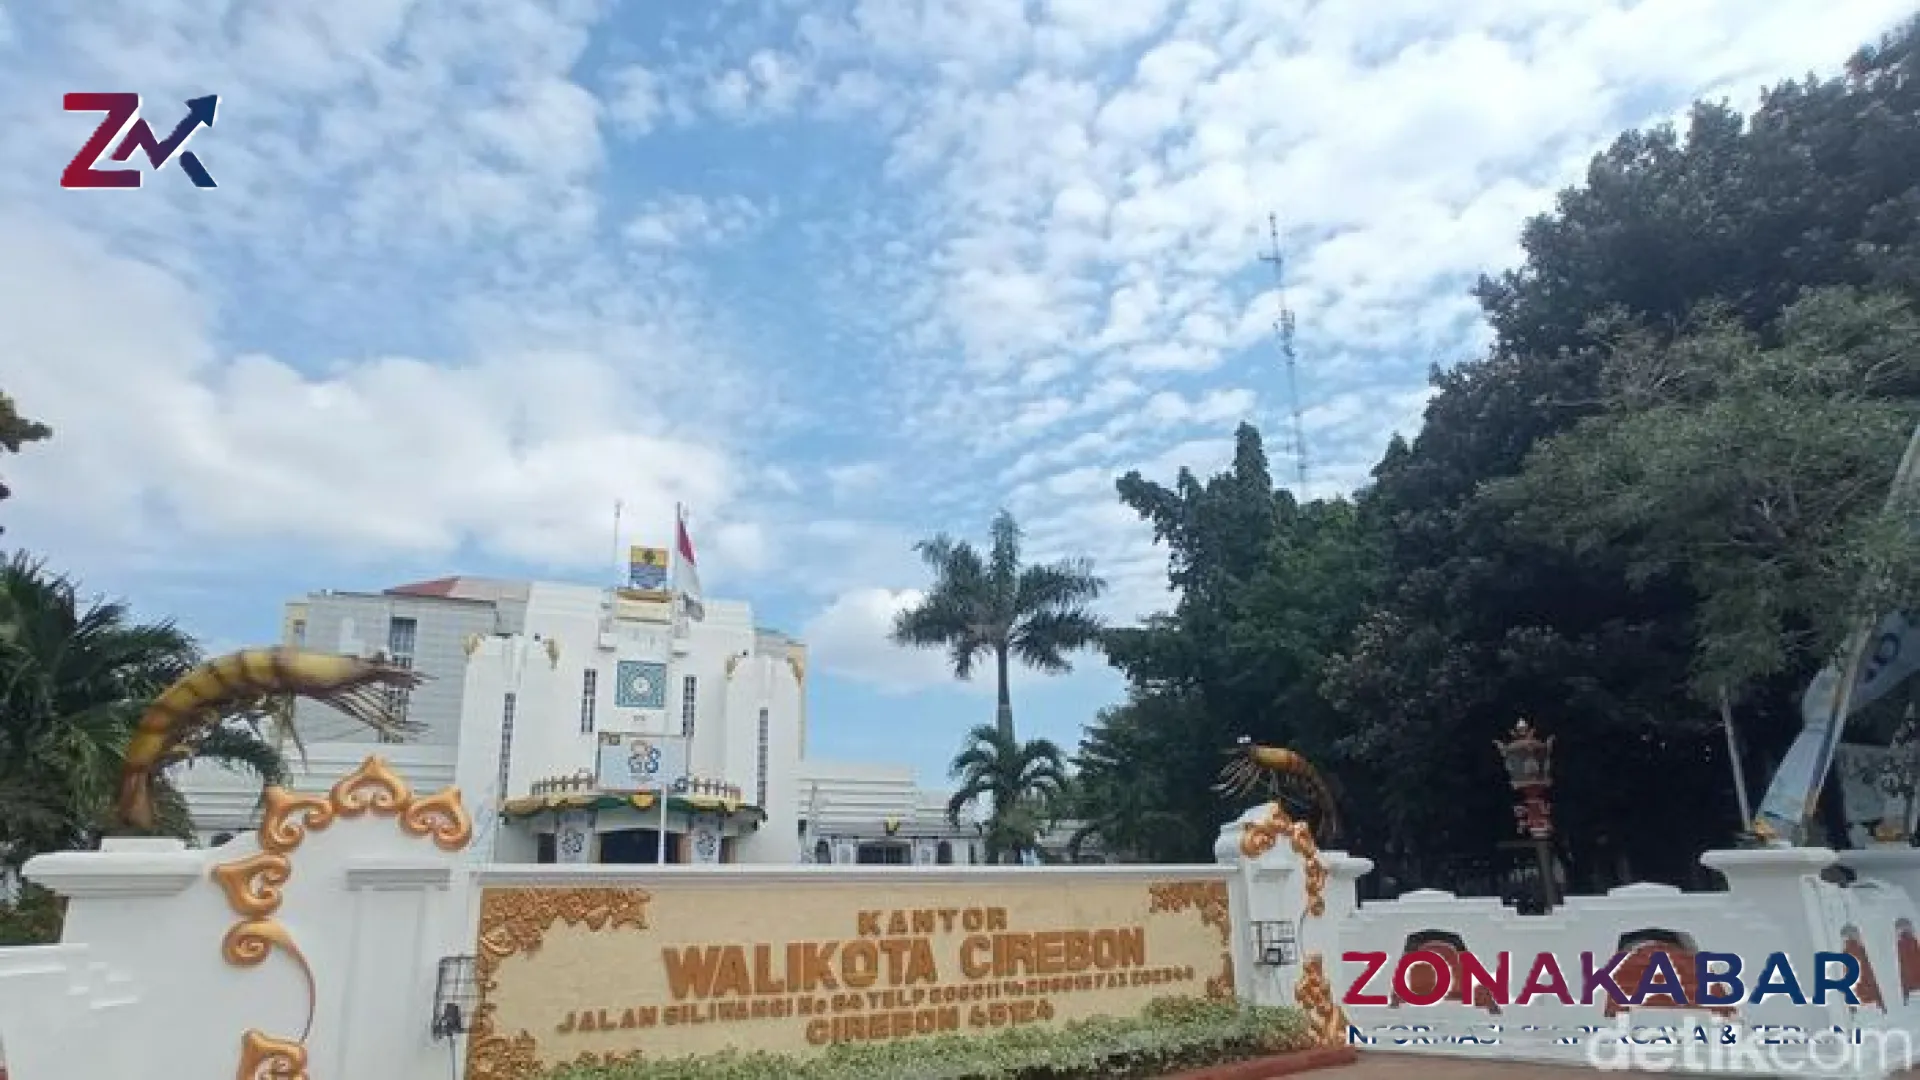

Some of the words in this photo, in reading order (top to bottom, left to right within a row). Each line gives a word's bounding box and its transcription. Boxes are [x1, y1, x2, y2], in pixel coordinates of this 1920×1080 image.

[858, 907, 1006, 936] KANTOR
[662, 939, 938, 998] WALIKOTA
[959, 928, 1145, 979] CIREBON
[557, 1005, 658, 1033] JALAN
[664, 998, 793, 1025] SILIWANGI
[806, 1005, 960, 1045] CIREBON
